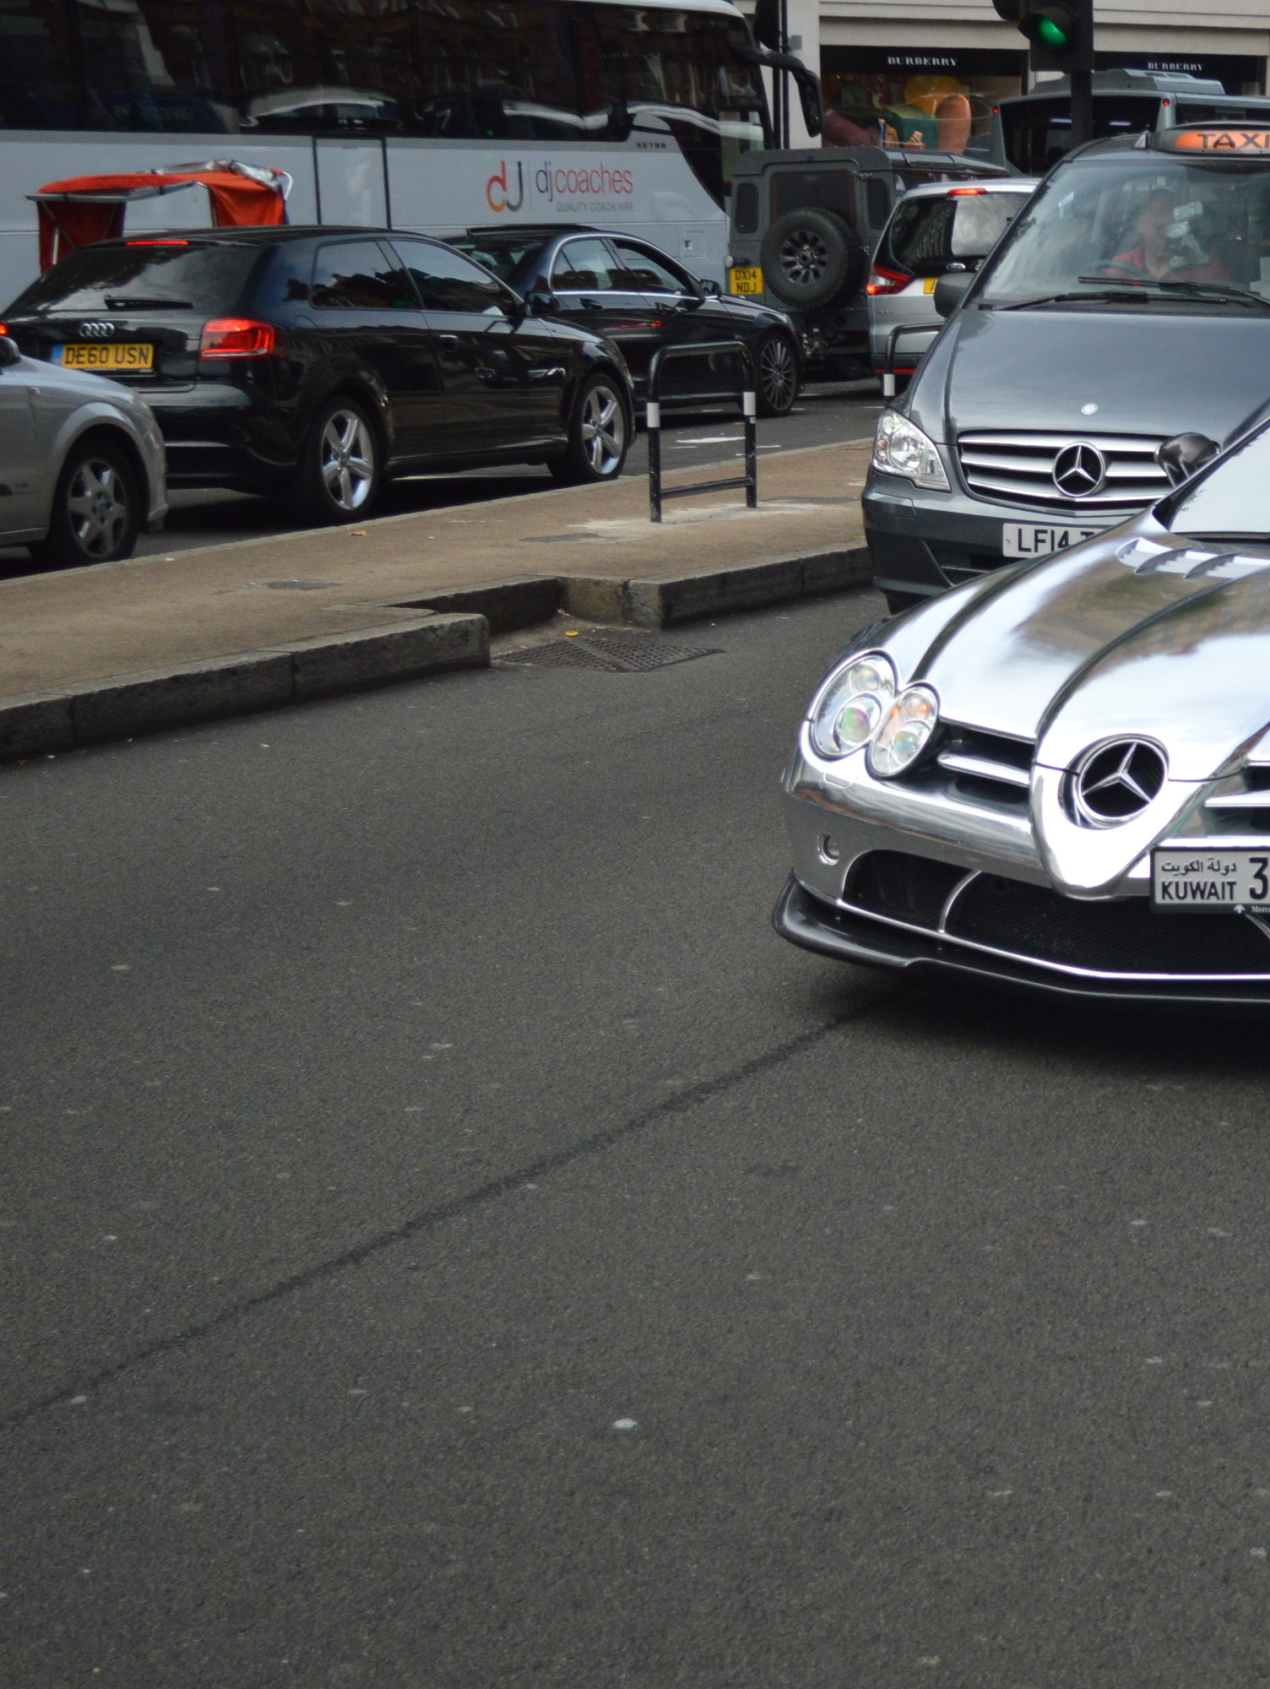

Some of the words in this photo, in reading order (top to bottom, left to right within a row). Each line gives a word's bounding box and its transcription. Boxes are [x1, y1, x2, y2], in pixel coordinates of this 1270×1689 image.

[887, 56, 957, 66] BURBERRY
[1147, 61, 1204, 71] BURBERRY
[1197, 133, 1270, 149] TAXI
[556, 201, 587, 212] QUALITY
[590, 202, 615, 212] COACH
[617, 202, 635, 212] HIRE
[736, 281, 757, 293] NDJ
[64, 346, 110, 365] DE60
[115, 346, 149, 365] USN
[1018, 528, 1070, 552] LF14
[1161, 858, 1204, 877] الكويت
[1208, 856, 1238, 875] دولة
[1161, 881, 1238, 901] KUWAIT
